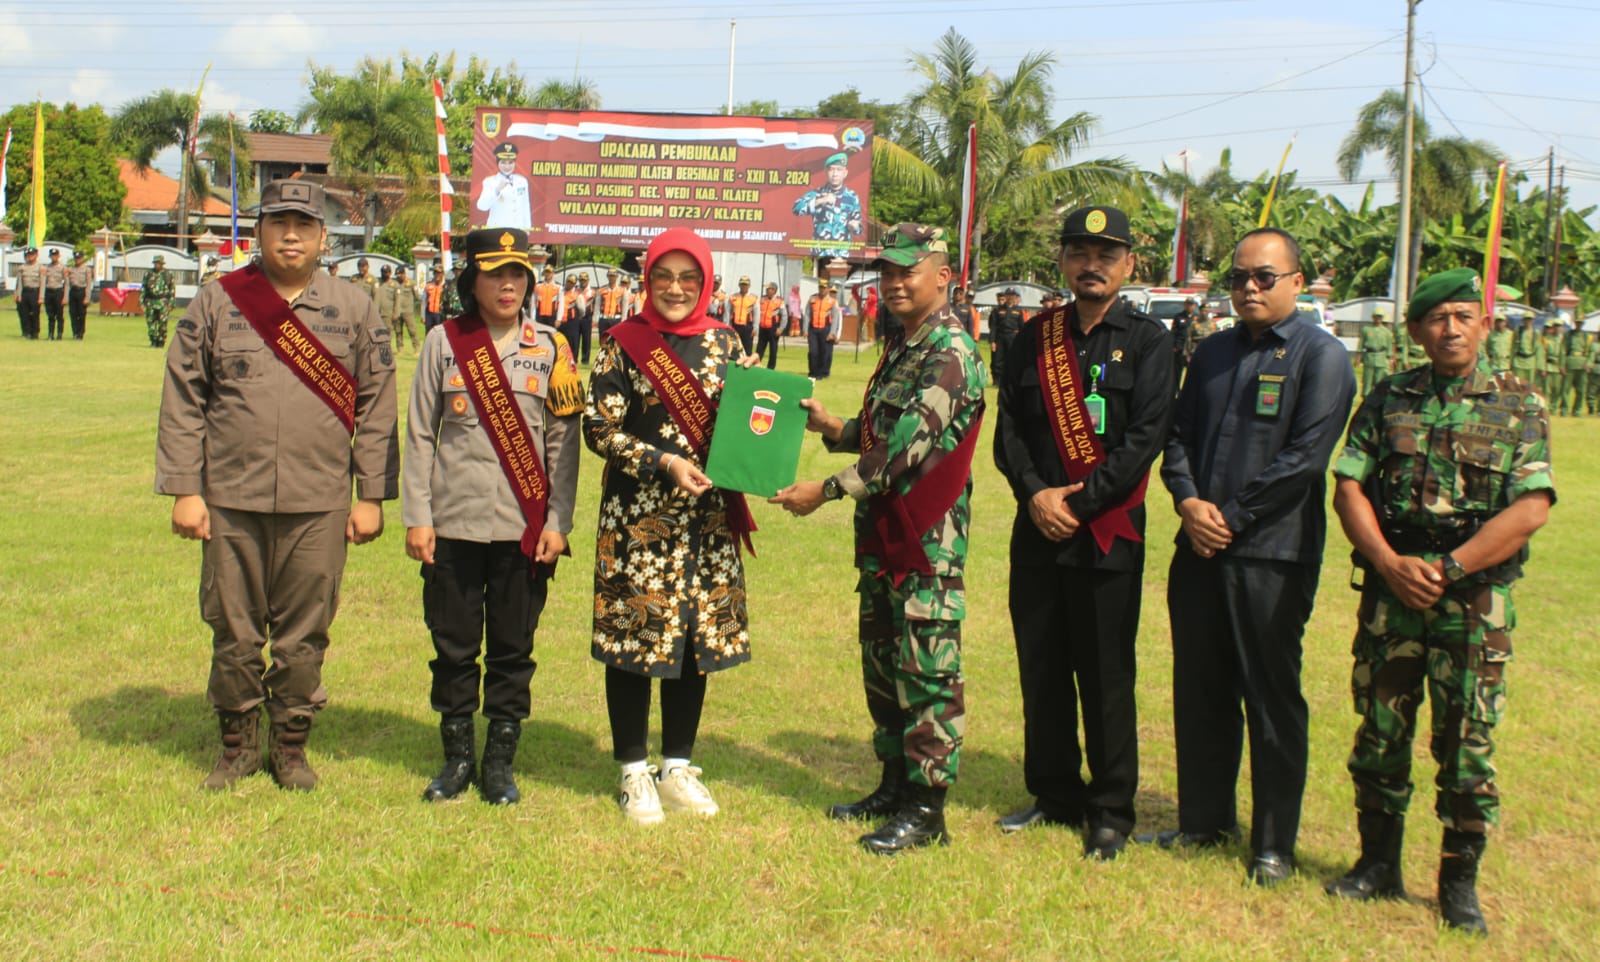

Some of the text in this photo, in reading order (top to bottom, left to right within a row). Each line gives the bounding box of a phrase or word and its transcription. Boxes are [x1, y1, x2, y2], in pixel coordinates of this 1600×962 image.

[600, 142, 737, 162] UPACARA PEMBUKAAN
[532, 161, 561, 176] KARYA
[565, 163, 597, 177] BHAKTI
[600, 164, 637, 178] MANDIRI
[640, 165, 673, 180] KLATEN
[676, 166, 720, 182] BERSINAR
[722, 168, 735, 182] KE
[746, 169, 765, 184] XXII
[768, 170, 782, 184] TA.
[786, 170, 810, 185] 2024
[565, 183, 759, 202] DESA PASUNG KEC. WEDI KAB. KLATEN
[559, 202, 617, 216] WILAYAH
[621, 203, 664, 217] KODIM
[668, 205, 701, 219] 0723
[714, 208, 763, 221] KLATEN
[599, 225, 639, 235] KABUPATEN
[276, 336, 296, 357] DESA
[293, 354, 321, 381] PASUNG
[279, 320, 317, 359] KBMKB
[312, 355, 346, 390] KE-XXII
[513, 359, 550, 376] POLRI
[650, 347, 685, 384] KBMKB
[1054, 345, 1073, 387] KE-XXII
[466, 359, 480, 381] DESA
[475, 380, 495, 413] PASUNG
[646, 360, 664, 379] DESA
[661, 378, 684, 409] PASUNG
[474, 346, 545, 500] KBMKB KE-XXII TAHUN 2024
[1063, 387, 1085, 431] TAHUN
[1075, 431, 1096, 464] 2024
